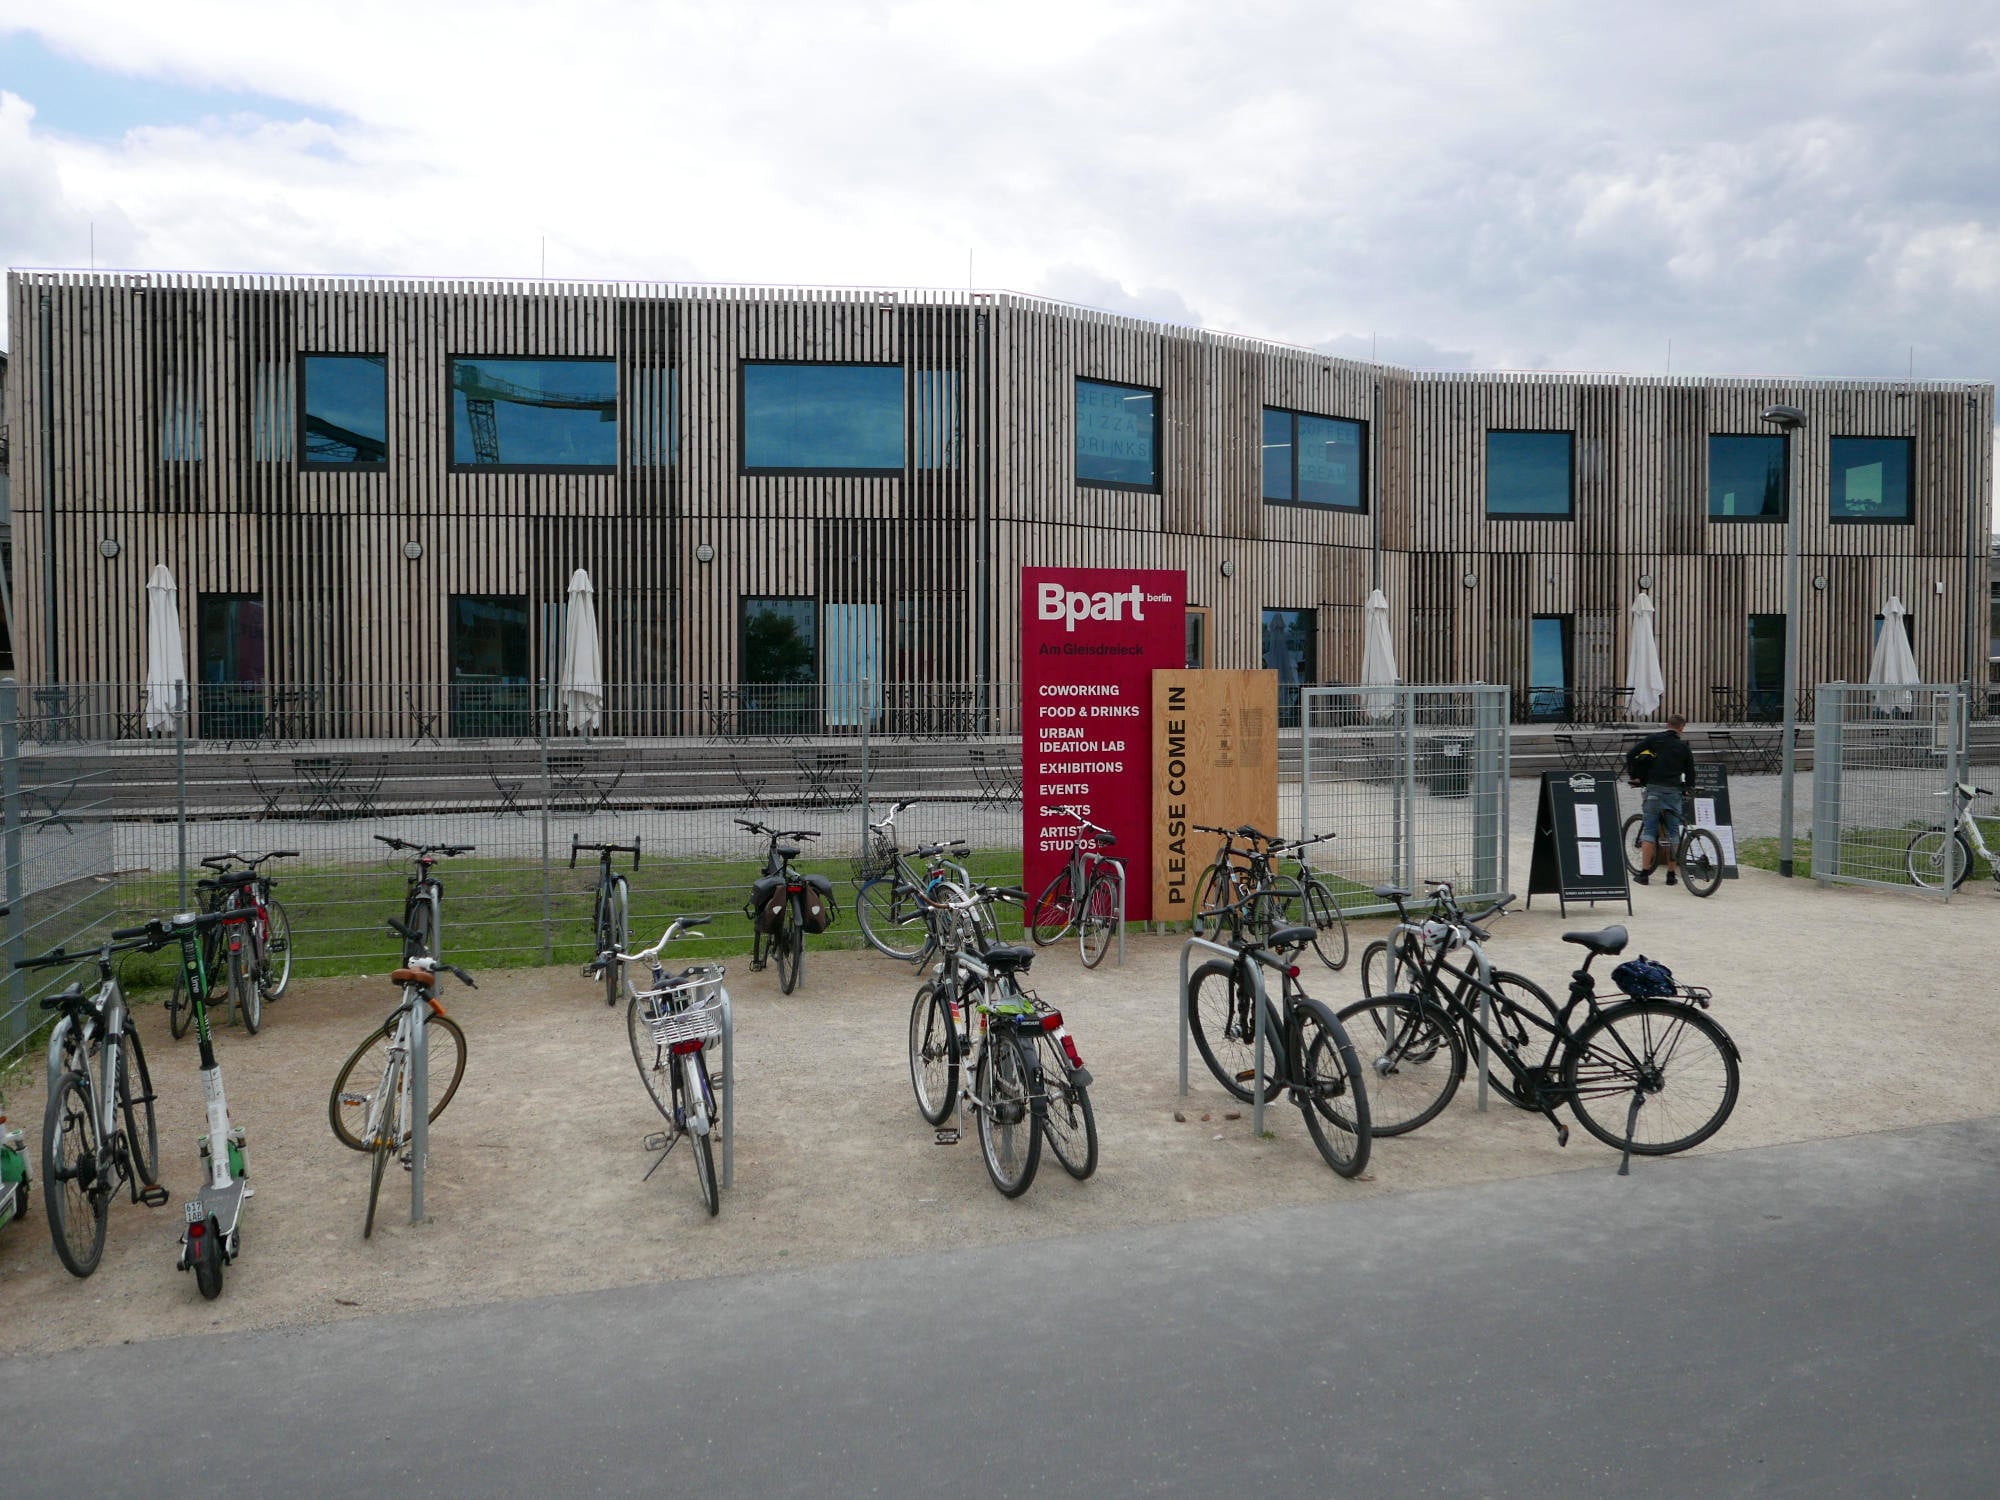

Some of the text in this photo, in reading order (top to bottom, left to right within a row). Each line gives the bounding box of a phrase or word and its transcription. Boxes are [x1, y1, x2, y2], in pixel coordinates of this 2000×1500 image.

[1038, 583, 1172, 632] Bpart berlin
[1039, 643, 1143, 656] Am Gleisdreieck
[1039, 685, 1120, 697] COWORKING
[1040, 706, 1140, 717] FOOD & DRINKS
[1040, 727, 1084, 739] URBAN
[1040, 741, 1126, 753] IDEATION LAB
[1040, 762, 1124, 774] EXHIBITIONS
[1040, 784, 1090, 796] EVENTS
[1168, 687, 1186, 904] PLEASE COME IN
